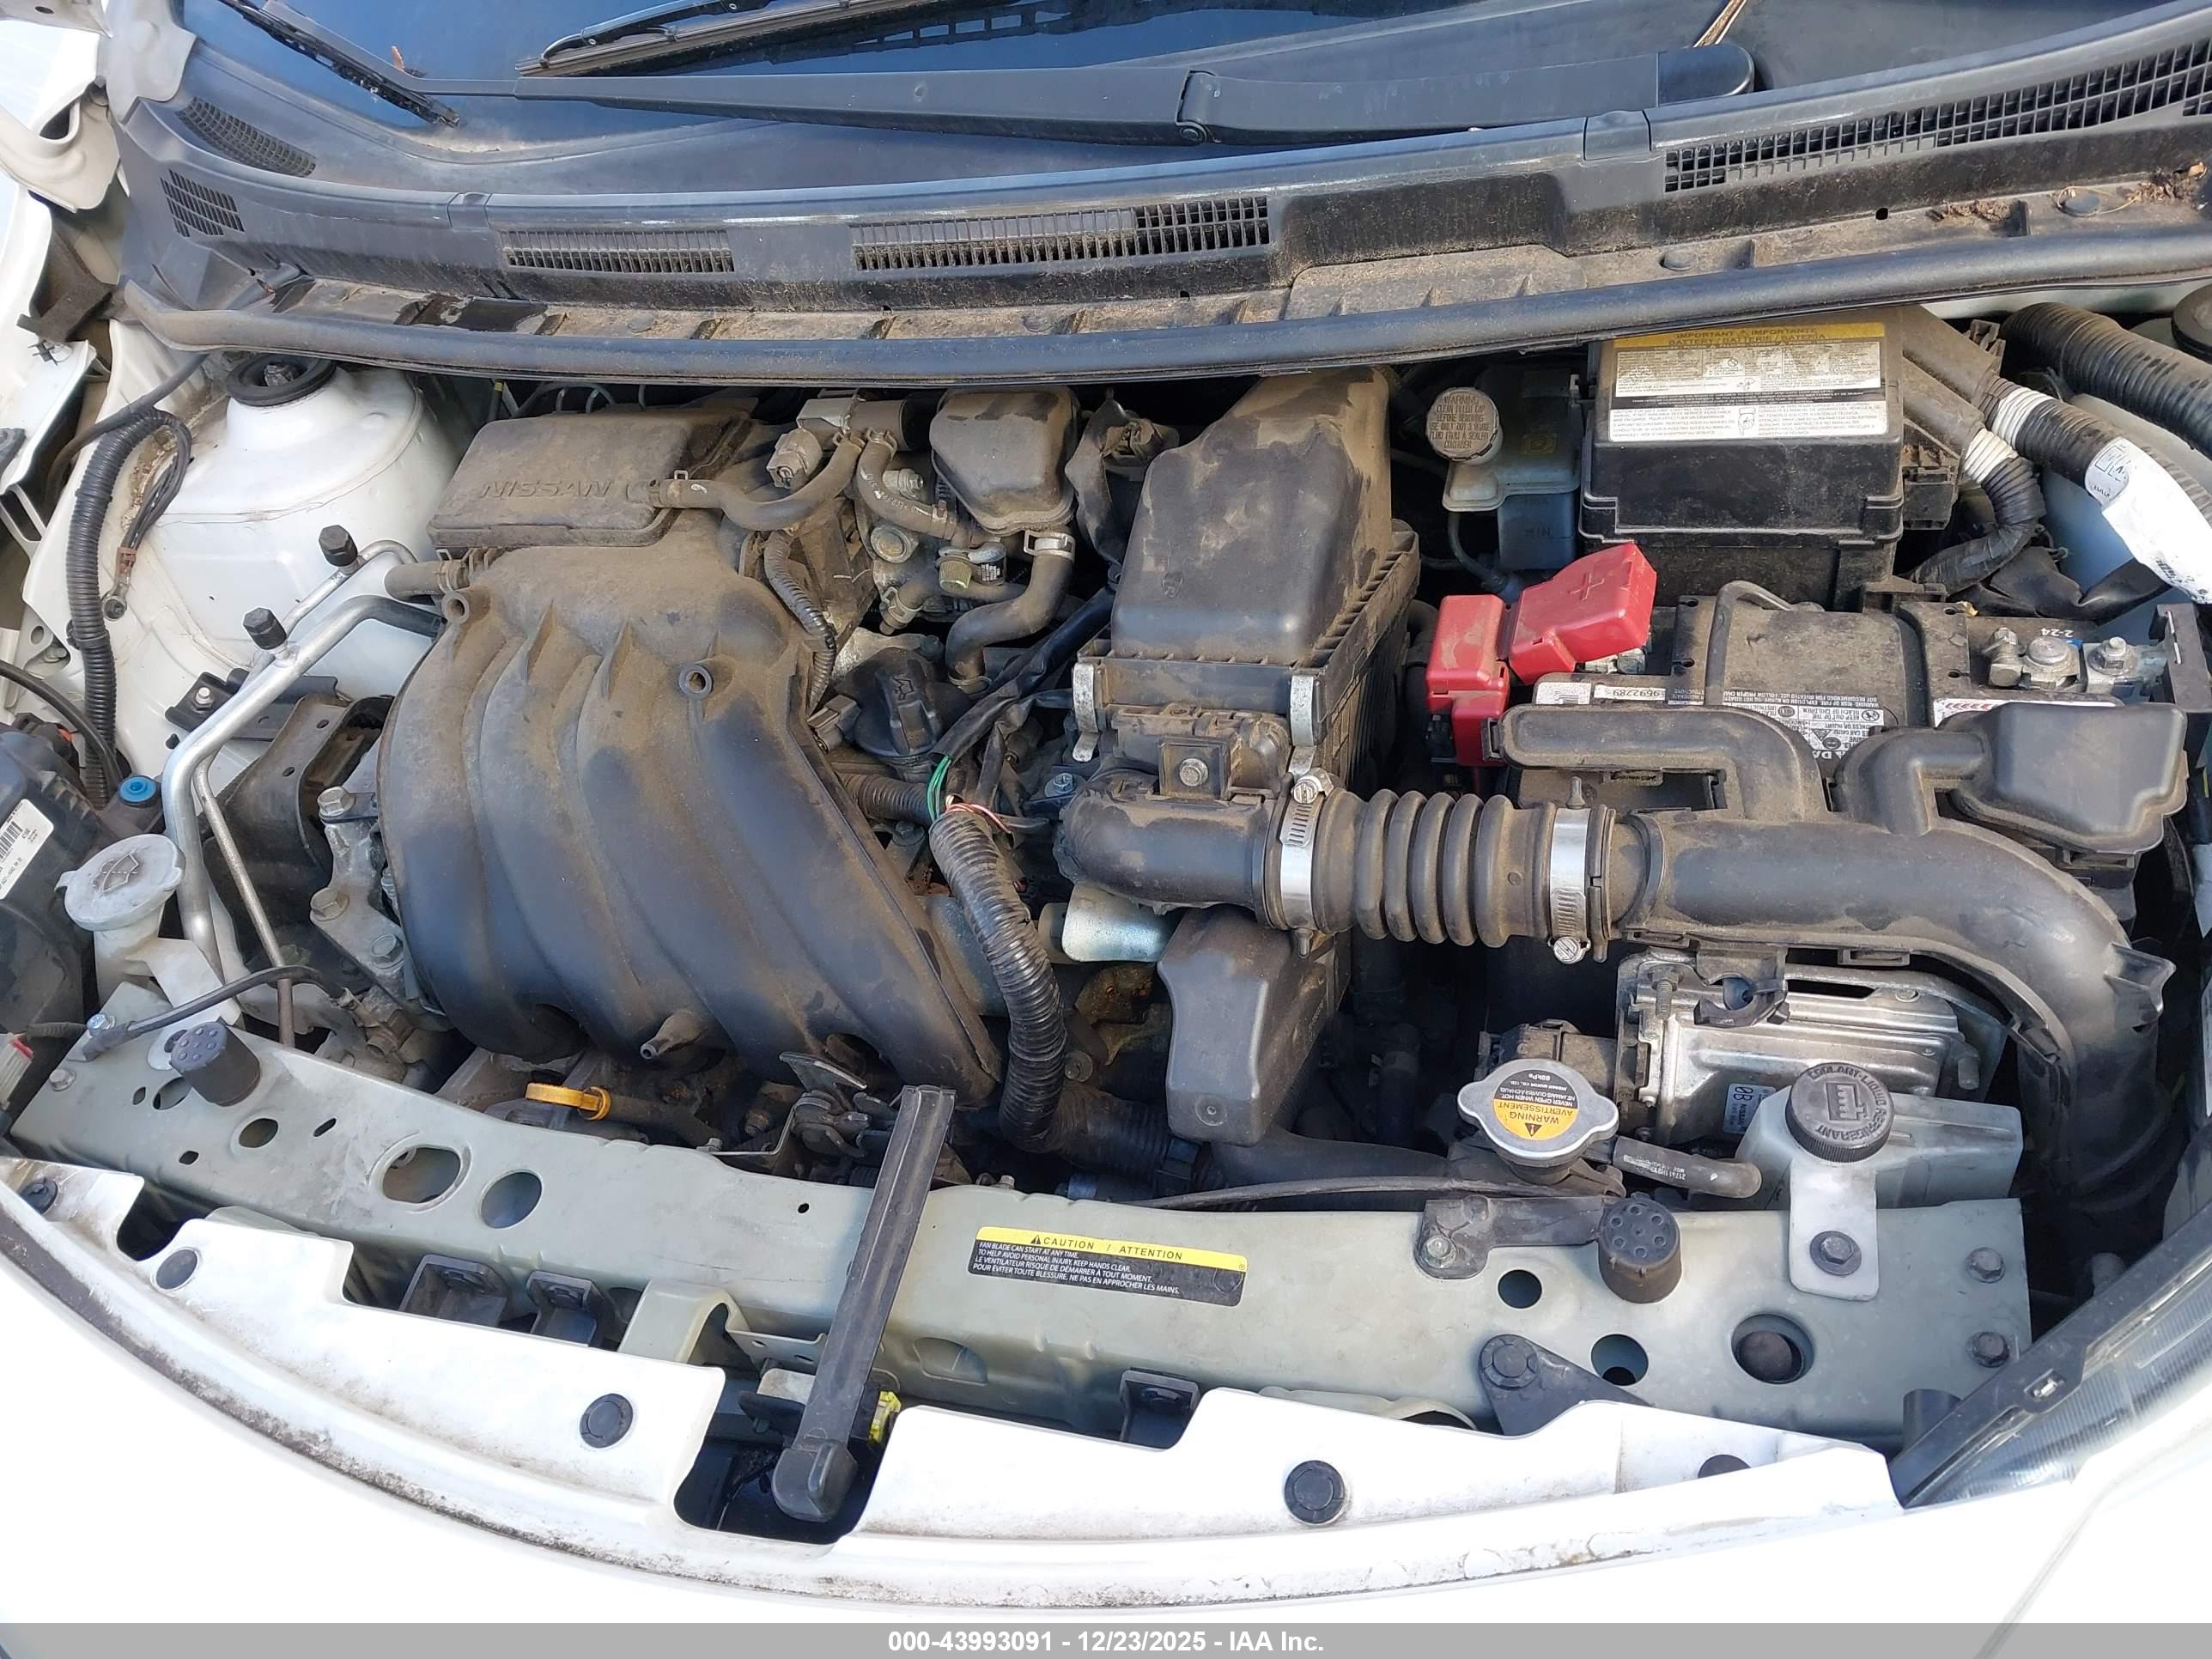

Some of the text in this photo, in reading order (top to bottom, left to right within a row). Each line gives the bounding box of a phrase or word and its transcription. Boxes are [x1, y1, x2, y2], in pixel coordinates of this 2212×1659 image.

[479, 480, 612, 499] NISSAN
[2040, 627, 2074, 638] 2-24
[1498, 1102, 1573, 1116] AVERTISSEMENT
[1509, 1111, 1559, 1125] WARNING
[1043, 1237, 1095, 1249] CAUTION
[1119, 1245, 1182, 1260] ATTENTION
[984, 1257, 1024, 1267] VENTILATEUR
[1025, 1261, 1048, 1271] RISQUE
[1060, 1265, 1096, 1275] DÉMARRER
[1096, 1267, 1102, 1276] À
[1121, 1273, 1152, 1283] MOMENT.
[1020, 1254, 1051, 1263] PERSONAL
[1089, 1261, 1109, 1269] HANDS
[992, 1264, 1013, 1273] ÉVITER
[1014, 1267, 1034, 1276] TOUTE
[1103, 1279, 1142, 1289] APPROCHER
[1156, 1285, 1179, 1294] MAINS.
